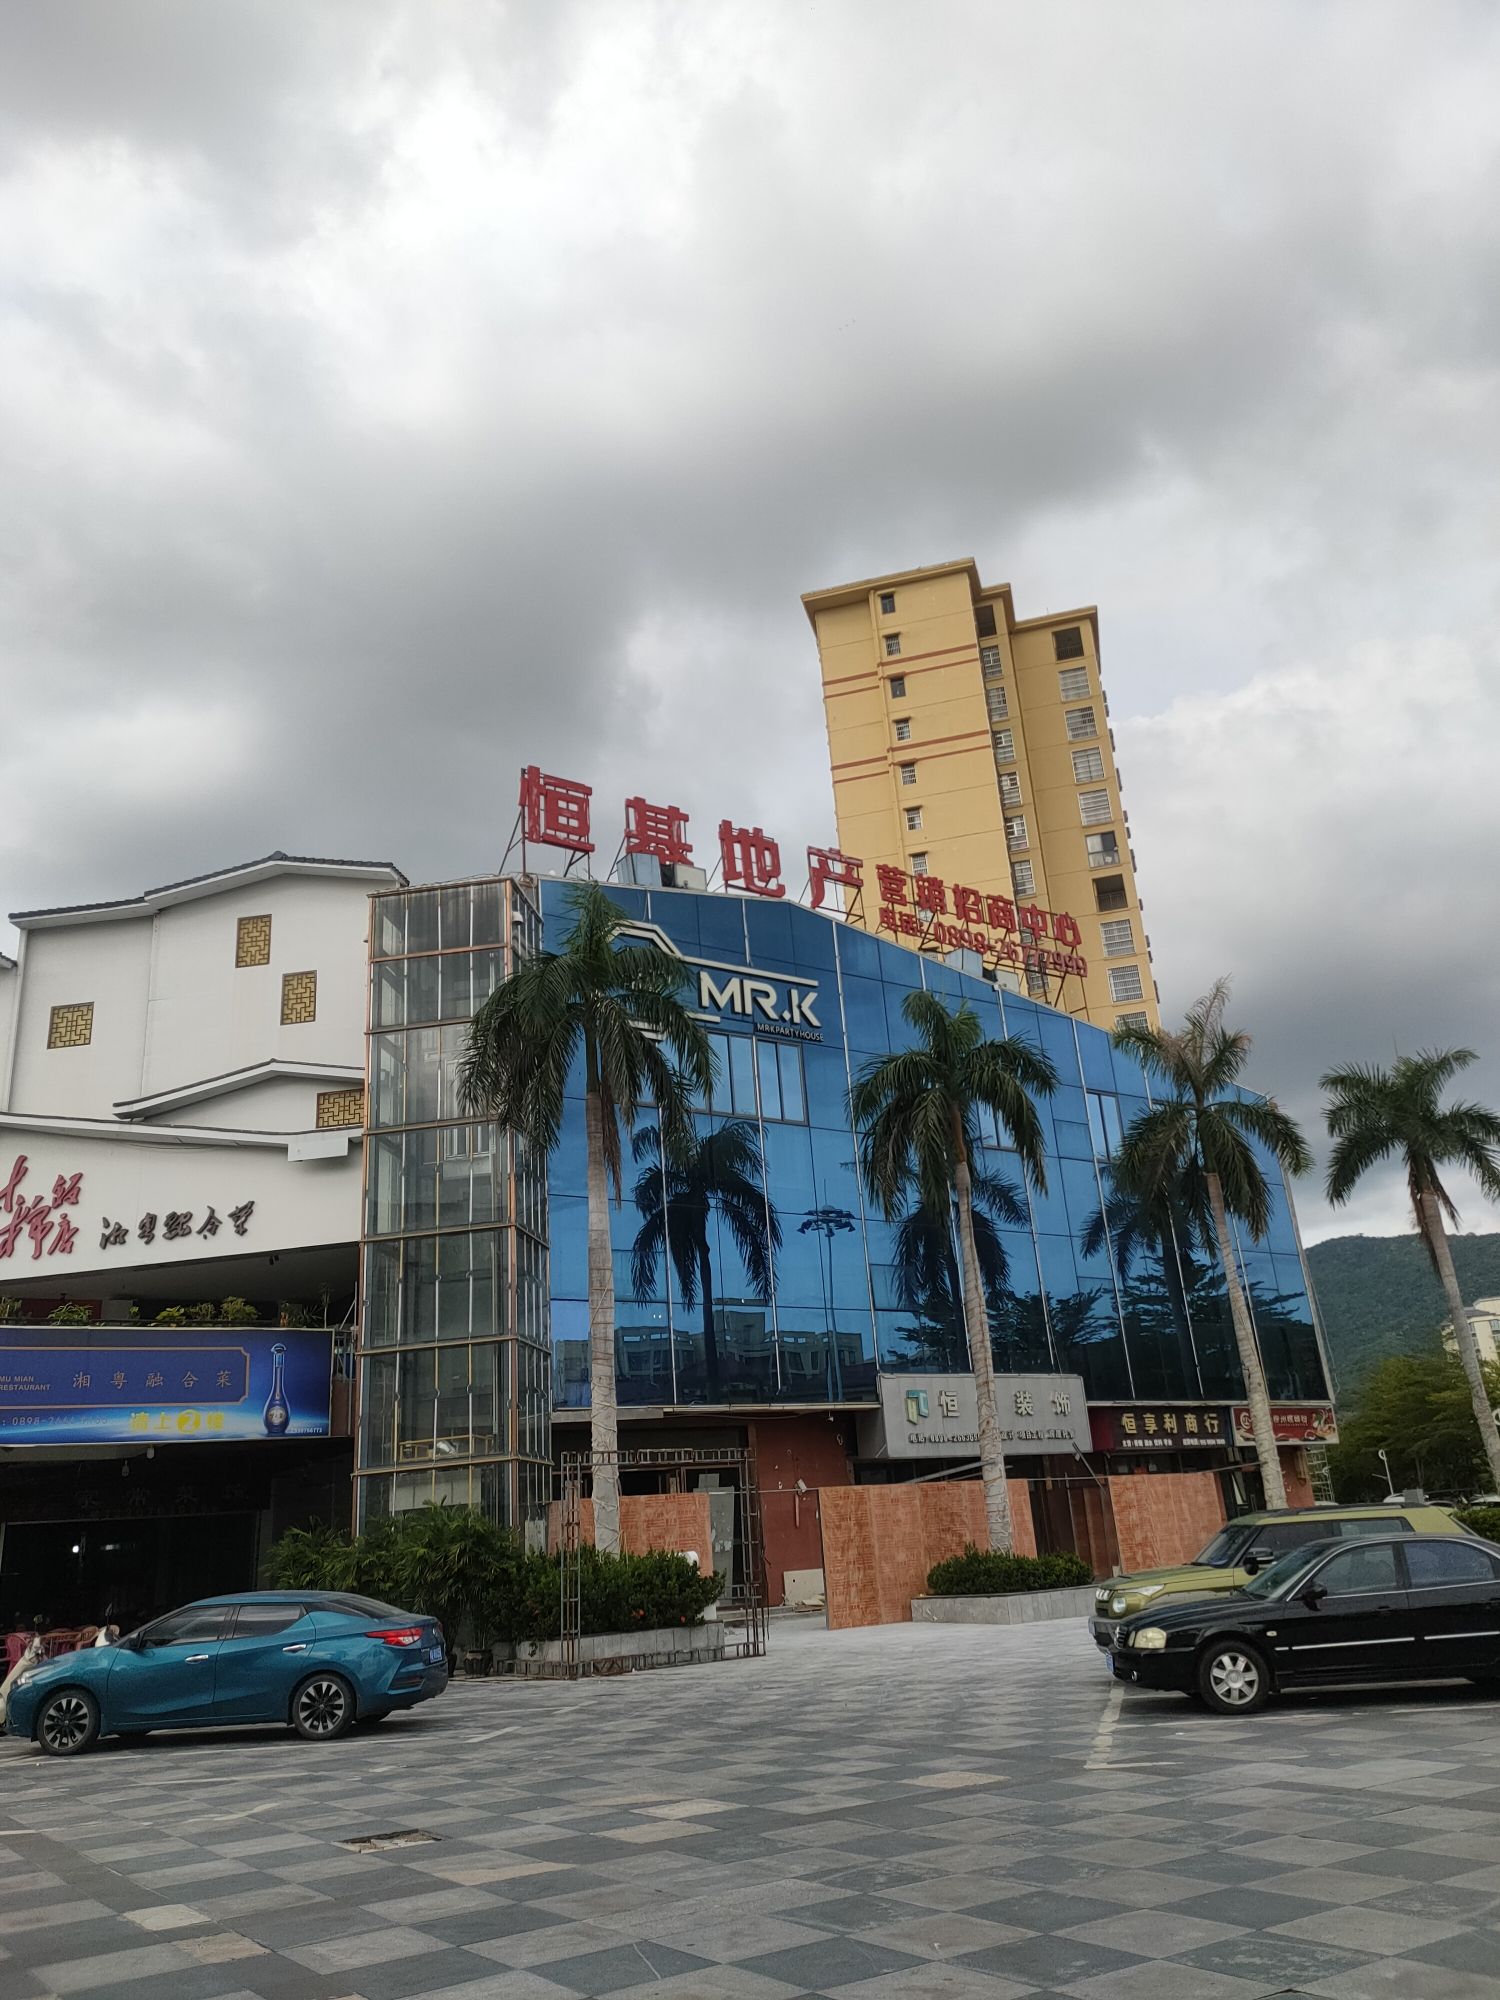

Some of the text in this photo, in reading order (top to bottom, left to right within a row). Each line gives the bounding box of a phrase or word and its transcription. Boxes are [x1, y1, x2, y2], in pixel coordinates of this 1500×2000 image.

[519, 765, 1082, 947] 恒基地产 营销招商中心
[699, 970, 821, 1027] MR.K
[73, 1371, 232, 1389] 湘粤融合菜
[938, 1389, 1071, 1418] 恒装饰
[1121, 1412, 1219, 1435] 恒享利商行
